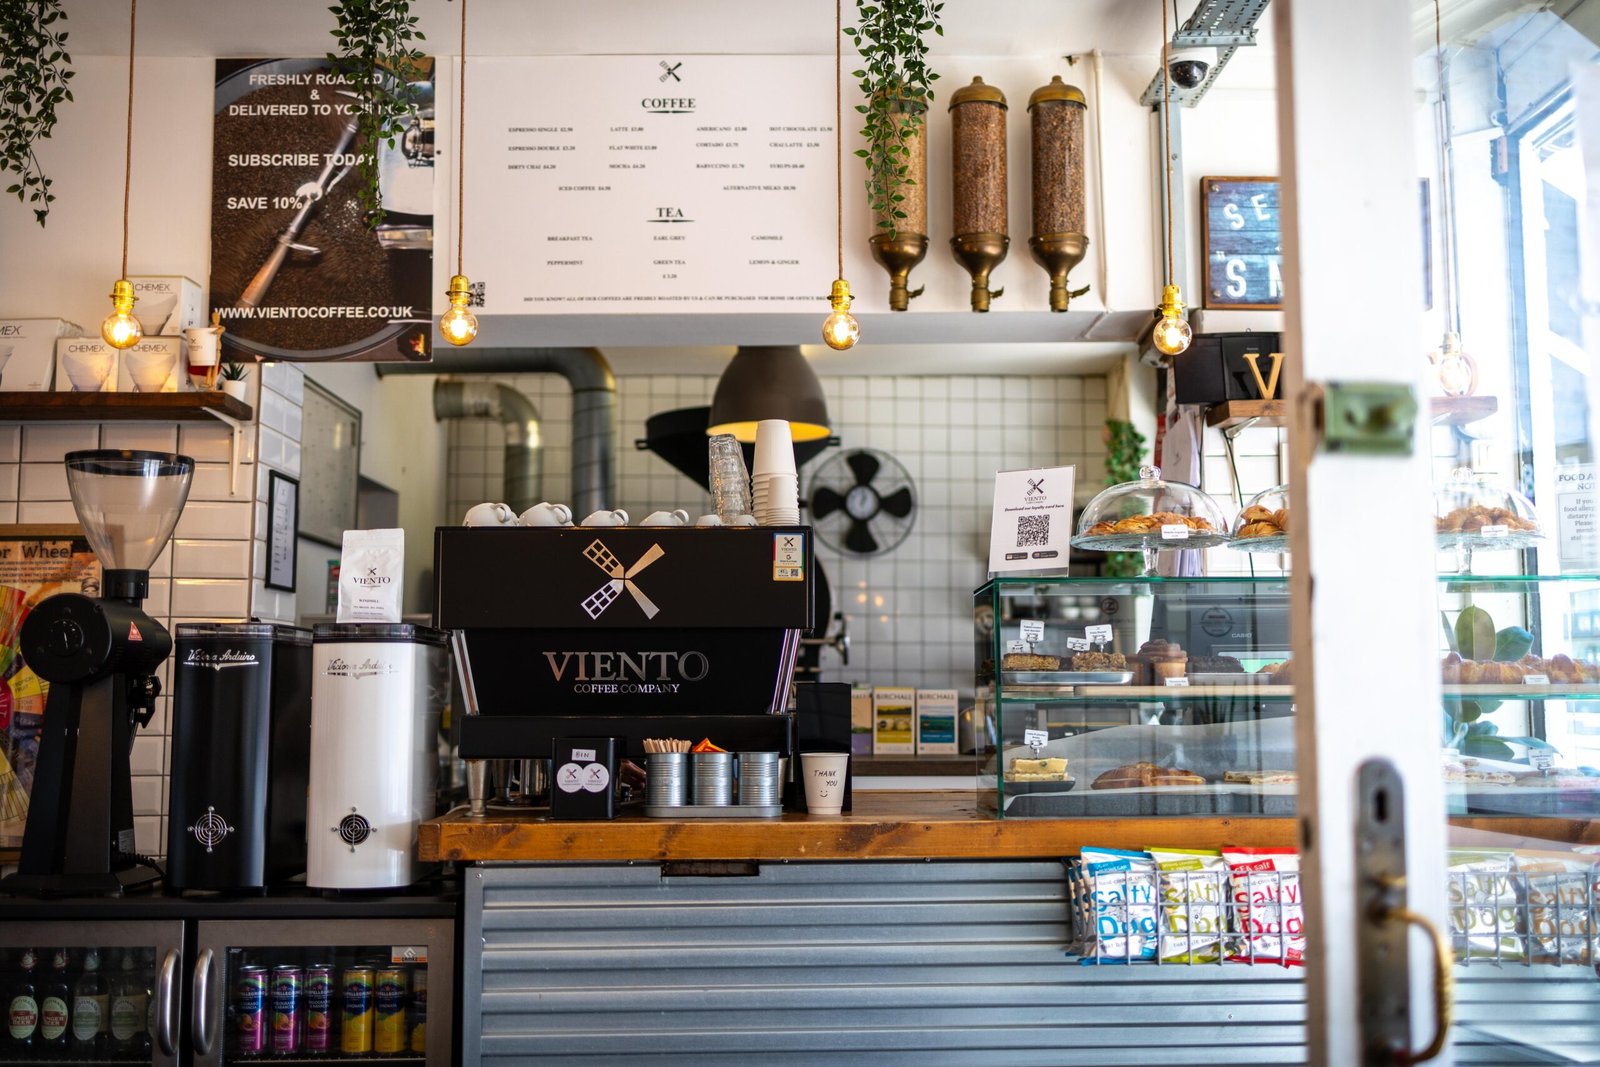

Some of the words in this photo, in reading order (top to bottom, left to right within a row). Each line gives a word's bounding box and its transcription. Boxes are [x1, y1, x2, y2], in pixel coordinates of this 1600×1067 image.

[250, 74, 313, 85] FRESHLY
[316, 74, 383, 85] ROAD
[310, 89, 320, 100] &
[641, 98, 696, 108] COFFEE
[229, 104, 308, 116] DELIVERED
[312, 104, 331, 116] TO
[228, 154, 319, 166] SUBSCRIBE
[227, 197, 268, 209] SAVE
[272, 197, 303, 209] 10%
[656, 207, 684, 218] TEA
[134, 283, 171, 292] CHEMEX
[214, 306, 413, 318] WWW.VIENTOCOFFEE.CO.UK
[68, 344, 105, 353] CHEMEX
[132, 344, 168, 353] CHEMEX
[1242, 352, 1286, 401] V
[1558, 473, 1586, 482] FOOD
[22, 544, 75, 559] Wheel
[353, 576, 391, 585] VIENTO
[219, 648, 256, 661] Arduino
[542, 650, 709, 682] VIENTO
[573, 683, 619, 694] COFFEE
[620, 683, 681, 694] COMPANY
[575, 751, 590, 759] BIN
[813, 769, 837, 777] THANK
[1253, 862, 1271, 871] salt
